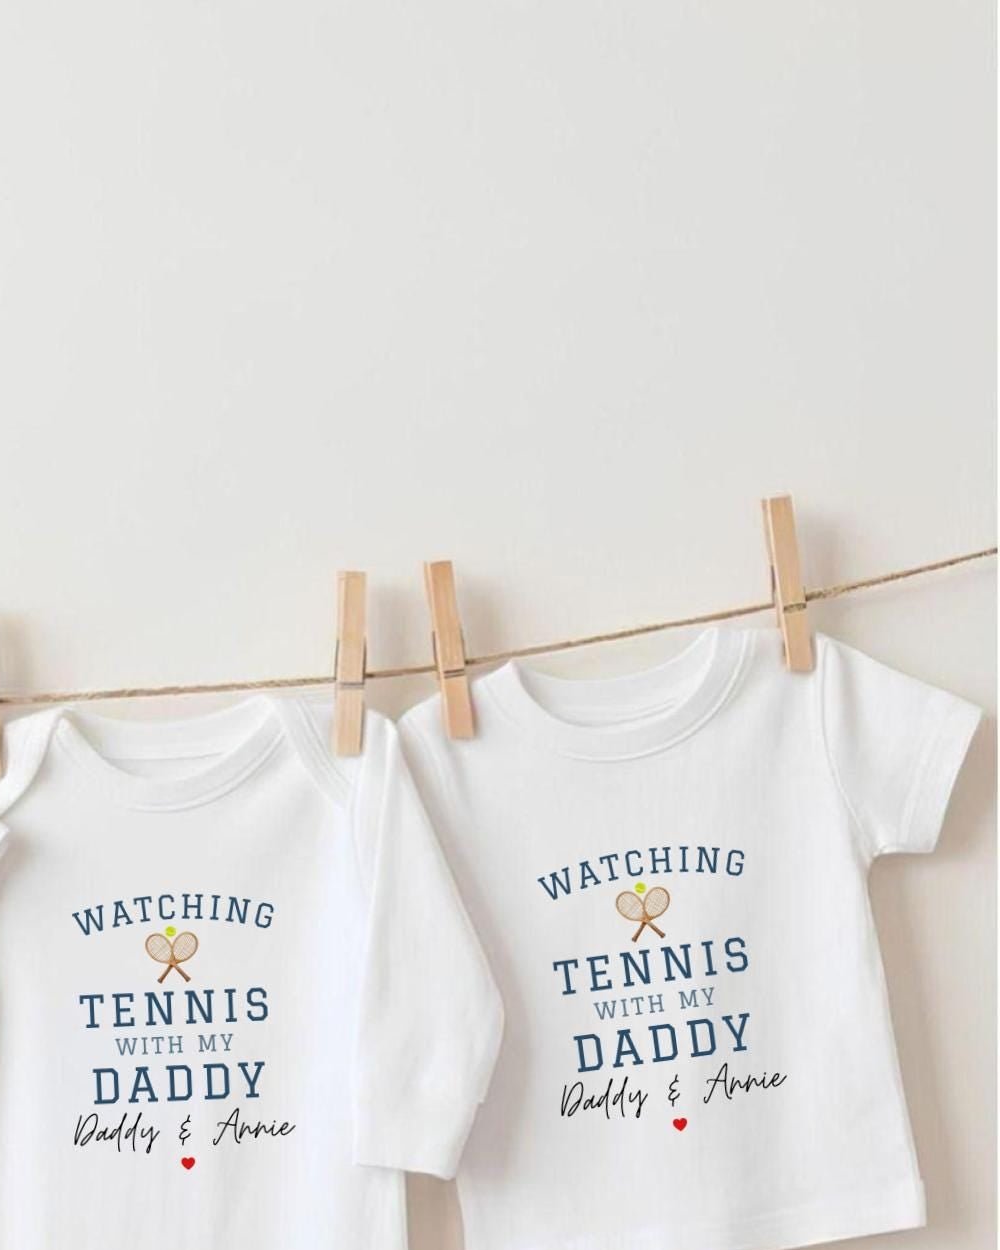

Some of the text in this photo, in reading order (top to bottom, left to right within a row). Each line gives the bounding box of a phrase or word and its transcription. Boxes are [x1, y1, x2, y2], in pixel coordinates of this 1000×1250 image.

[536, 845, 745, 901] WATCHING
[71, 893, 275, 937] WATCHING
[552, 936, 749, 997] TENNIS
[78, 986, 269, 1029] TENNIS
[593, 986, 716, 1021] WITH MY
[114, 1033, 235, 1057] WITH MY
[572, 1012, 751, 1074] DADDY
[91, 1060, 266, 1106] DADDY
[559, 1061, 788, 1120] Daddy & Annie
[73, 1107, 297, 1155] Daddy & Annie
